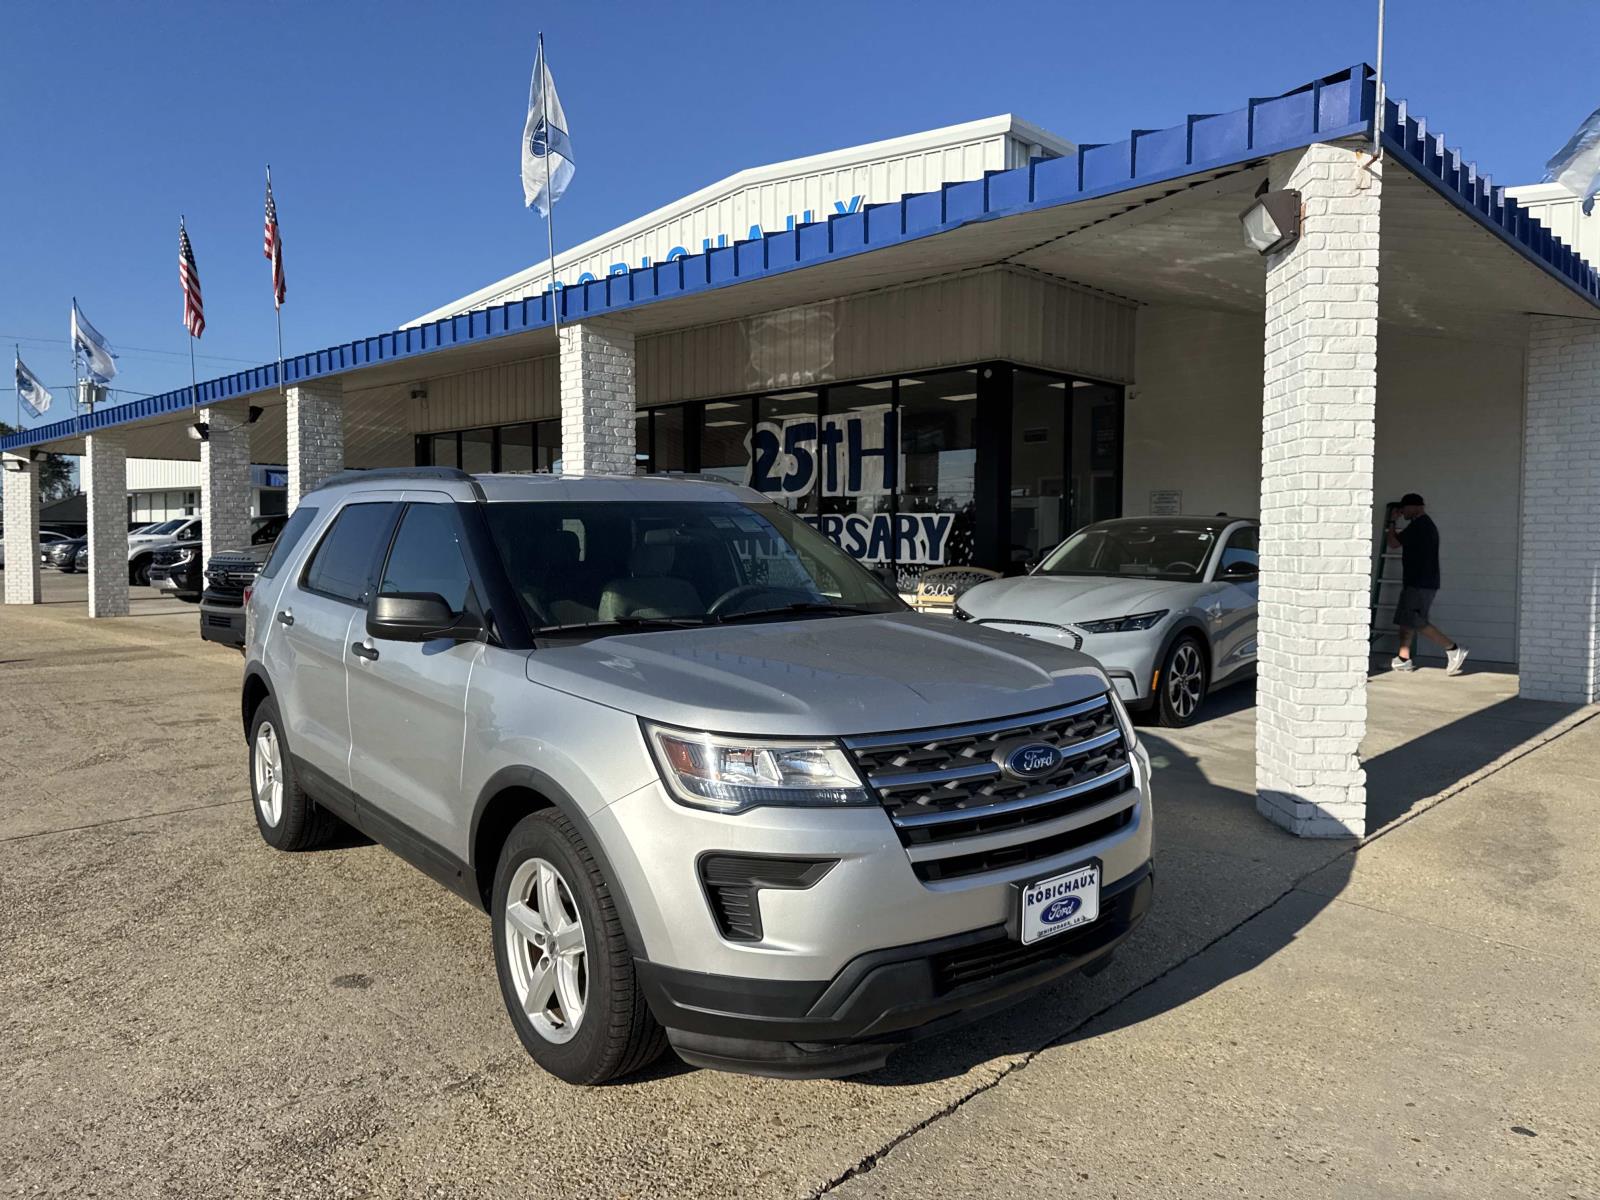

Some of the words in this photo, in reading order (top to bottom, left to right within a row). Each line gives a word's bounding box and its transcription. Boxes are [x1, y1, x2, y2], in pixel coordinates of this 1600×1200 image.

[1024, 749, 1054, 770] Ford
[1027, 873, 1095, 906] ROBICHAUX
[1048, 900, 1075, 920] Ford
